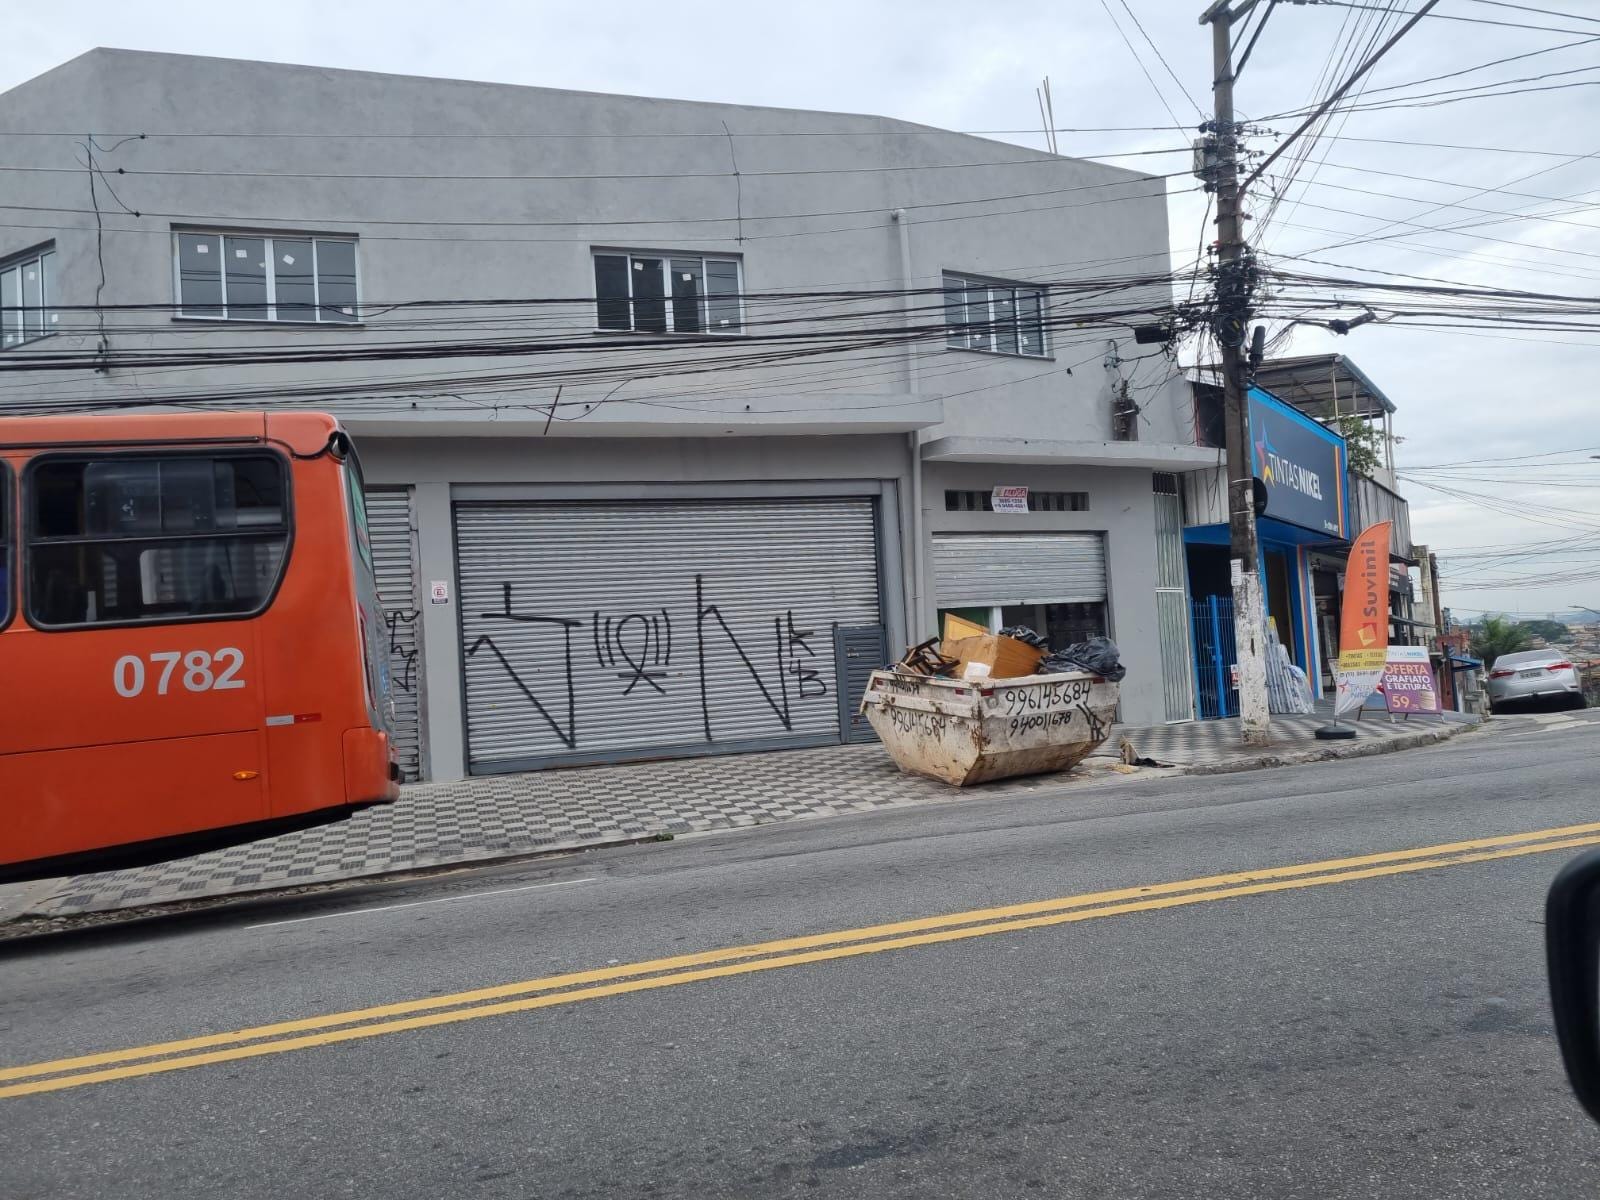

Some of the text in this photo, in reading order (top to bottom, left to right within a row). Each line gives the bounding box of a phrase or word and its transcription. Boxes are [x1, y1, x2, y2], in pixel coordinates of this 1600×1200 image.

[1361, 541, 1377, 617] Suvinil
[113, 648, 246, 698] 0782
[1385, 664, 1429, 675] OFERTA
[1386, 674, 1430, 683] GRAFIATO
[1394, 682, 1433, 691] TEXTURAS
[1006, 681, 1091, 715] 996145684
[1391, 695, 1410, 708] 59
